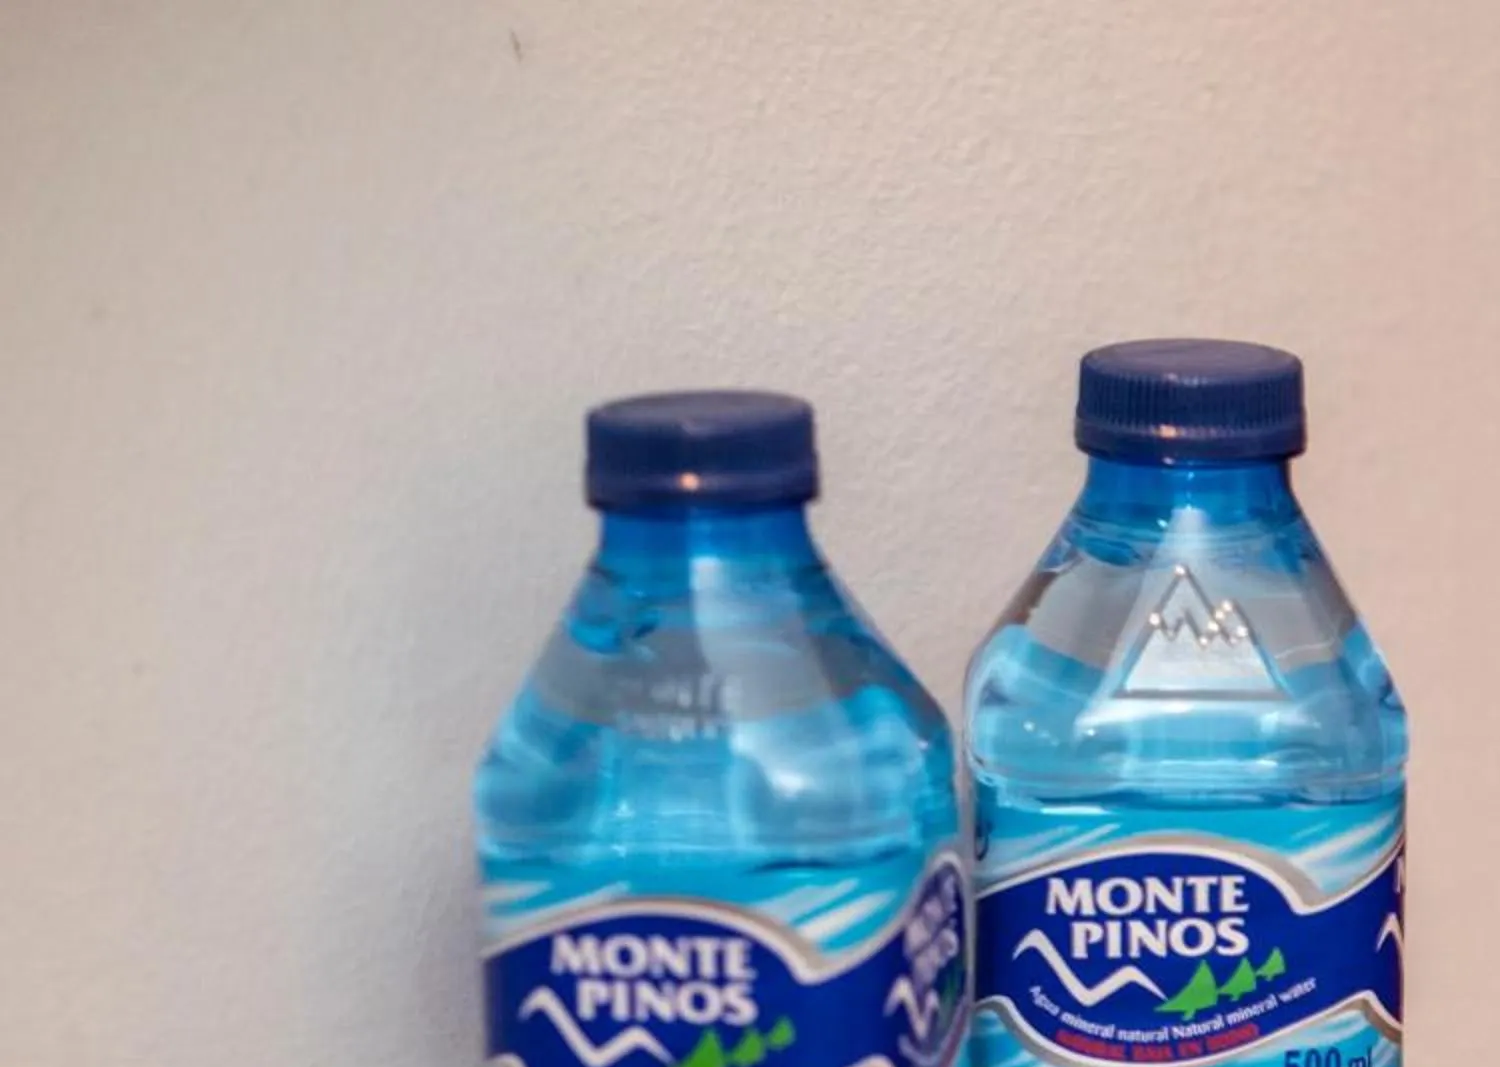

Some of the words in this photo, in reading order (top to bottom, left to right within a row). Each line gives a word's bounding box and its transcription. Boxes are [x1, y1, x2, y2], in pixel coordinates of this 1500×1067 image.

[1045, 874, 1250, 917] MONTE
[550, 933, 759, 981] MONTE
[1070, 917, 1250, 959] PINOS
[575, 979, 759, 1027] PINOS
[1028, 984, 1061, 1017] Agua
[1060, 1010, 1116, 1040] mineral
[1117, 1026, 1170, 1043] natural
[1171, 1012, 1225, 1040] Natural
[1226, 993, 1279, 1025] mineral
[1278, 976, 1318, 1004] water
